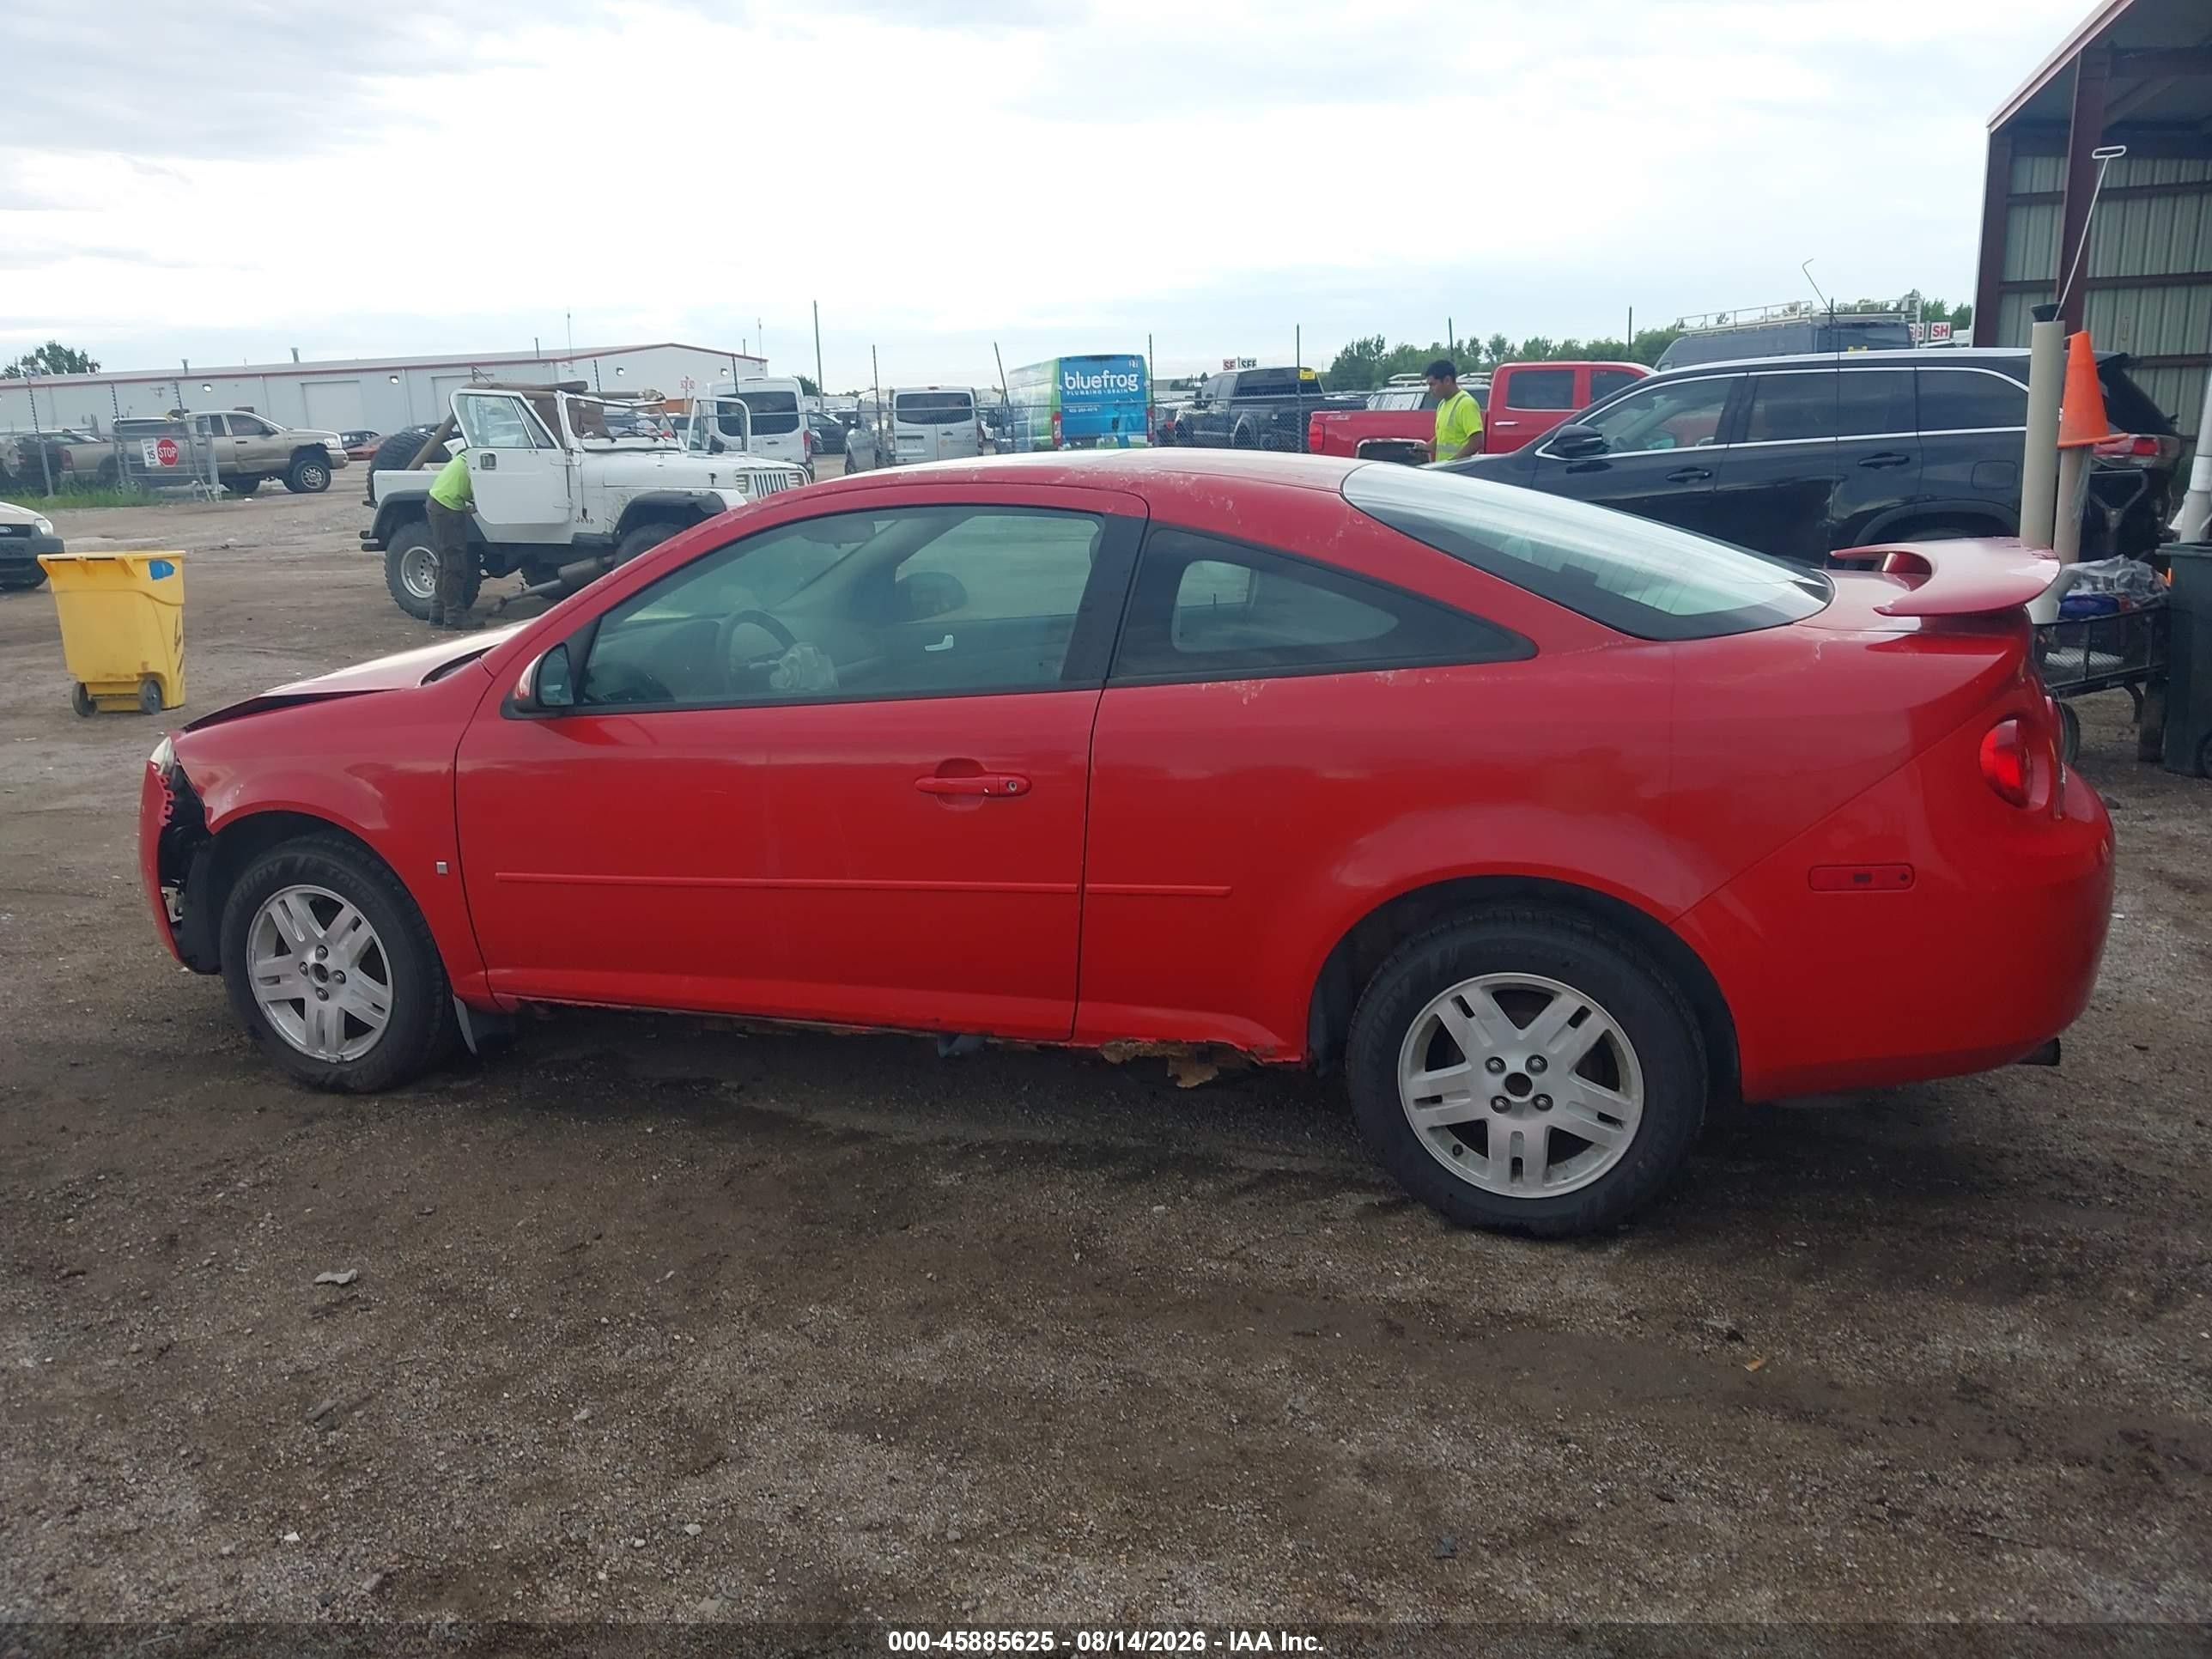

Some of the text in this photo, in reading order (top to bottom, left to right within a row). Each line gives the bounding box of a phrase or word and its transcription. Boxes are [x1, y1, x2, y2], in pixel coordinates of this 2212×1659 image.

[1932, 325, 1949, 338] SH
[1224, 361, 1237, 370] SE
[1064, 369, 1139, 392] bluefrog
[147, 449, 156, 460] 15
[158, 447, 177, 459] STOP
